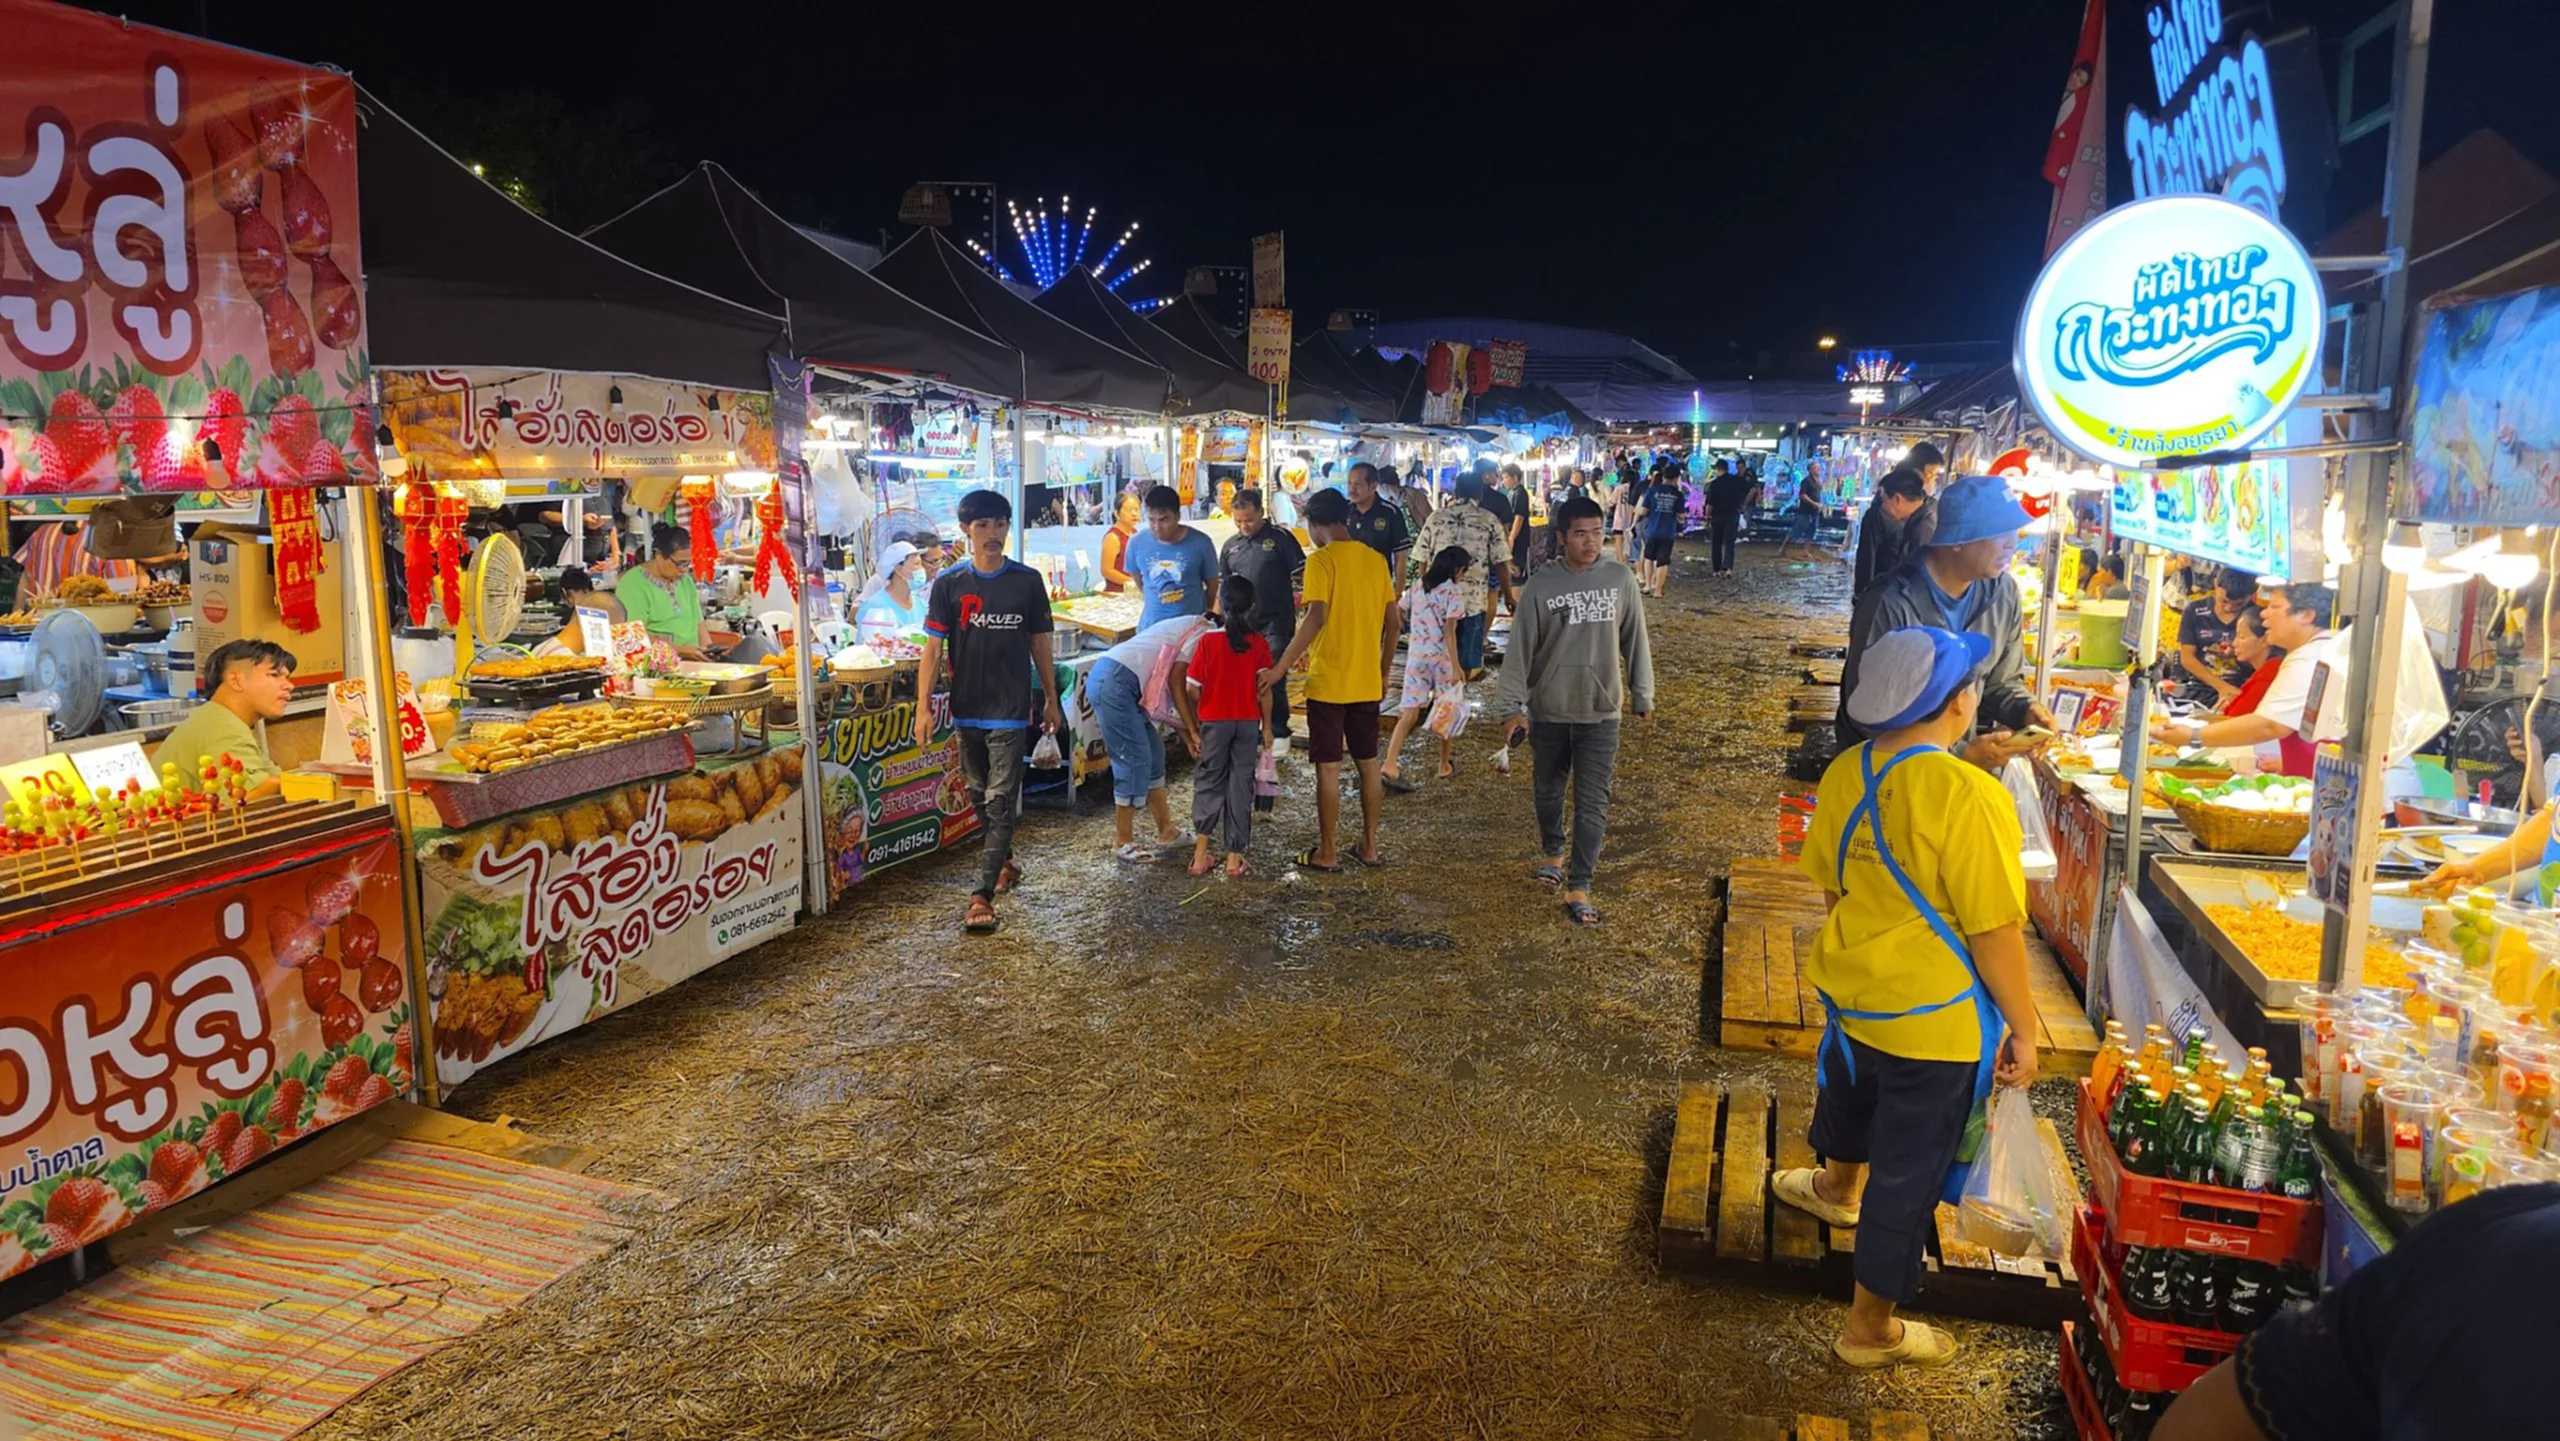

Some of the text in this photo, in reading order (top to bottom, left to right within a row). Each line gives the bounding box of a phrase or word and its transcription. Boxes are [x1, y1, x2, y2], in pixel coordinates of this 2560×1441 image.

[2137, 245, 2267, 302] ผัดไทย
[2056, 278, 2295, 386] กระทงทอง
[1251, 361, 1279, 379] 100
[199, 572, 230, 584] HS-800
[960, 594, 1024, 631] PRAKUED
[1546, 588, 1618, 610] ROSEVILLE
[1569, 600, 1617, 613] TRACK
[868, 828, 936, 863] 091-4161542
[480, 785, 678, 946] ไส้อั่ว
[581, 843, 775, 1000] สุดอร่อย
[730, 906, 787, 938] 081-6692542
